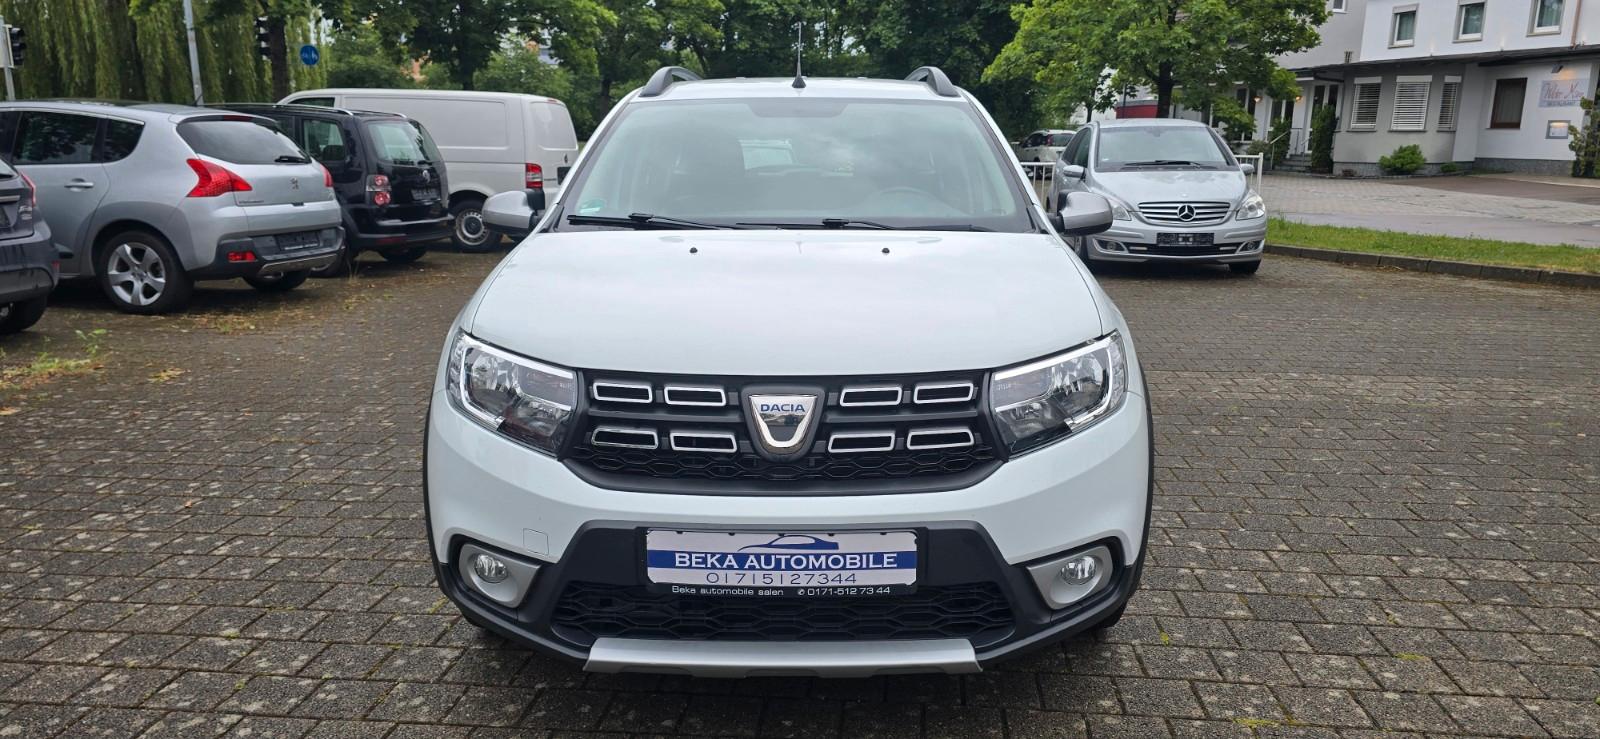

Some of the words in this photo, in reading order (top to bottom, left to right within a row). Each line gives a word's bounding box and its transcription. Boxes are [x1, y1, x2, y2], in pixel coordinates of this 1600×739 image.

[760, 403, 805, 412] DACIA
[674, 552, 740, 569] BEKA
[743, 552, 898, 570] AUTOMOBILE
[706, 572, 857, 585] 01715127344
[671, 585, 697, 594] Beka
[700, 587, 754, 596] automobile
